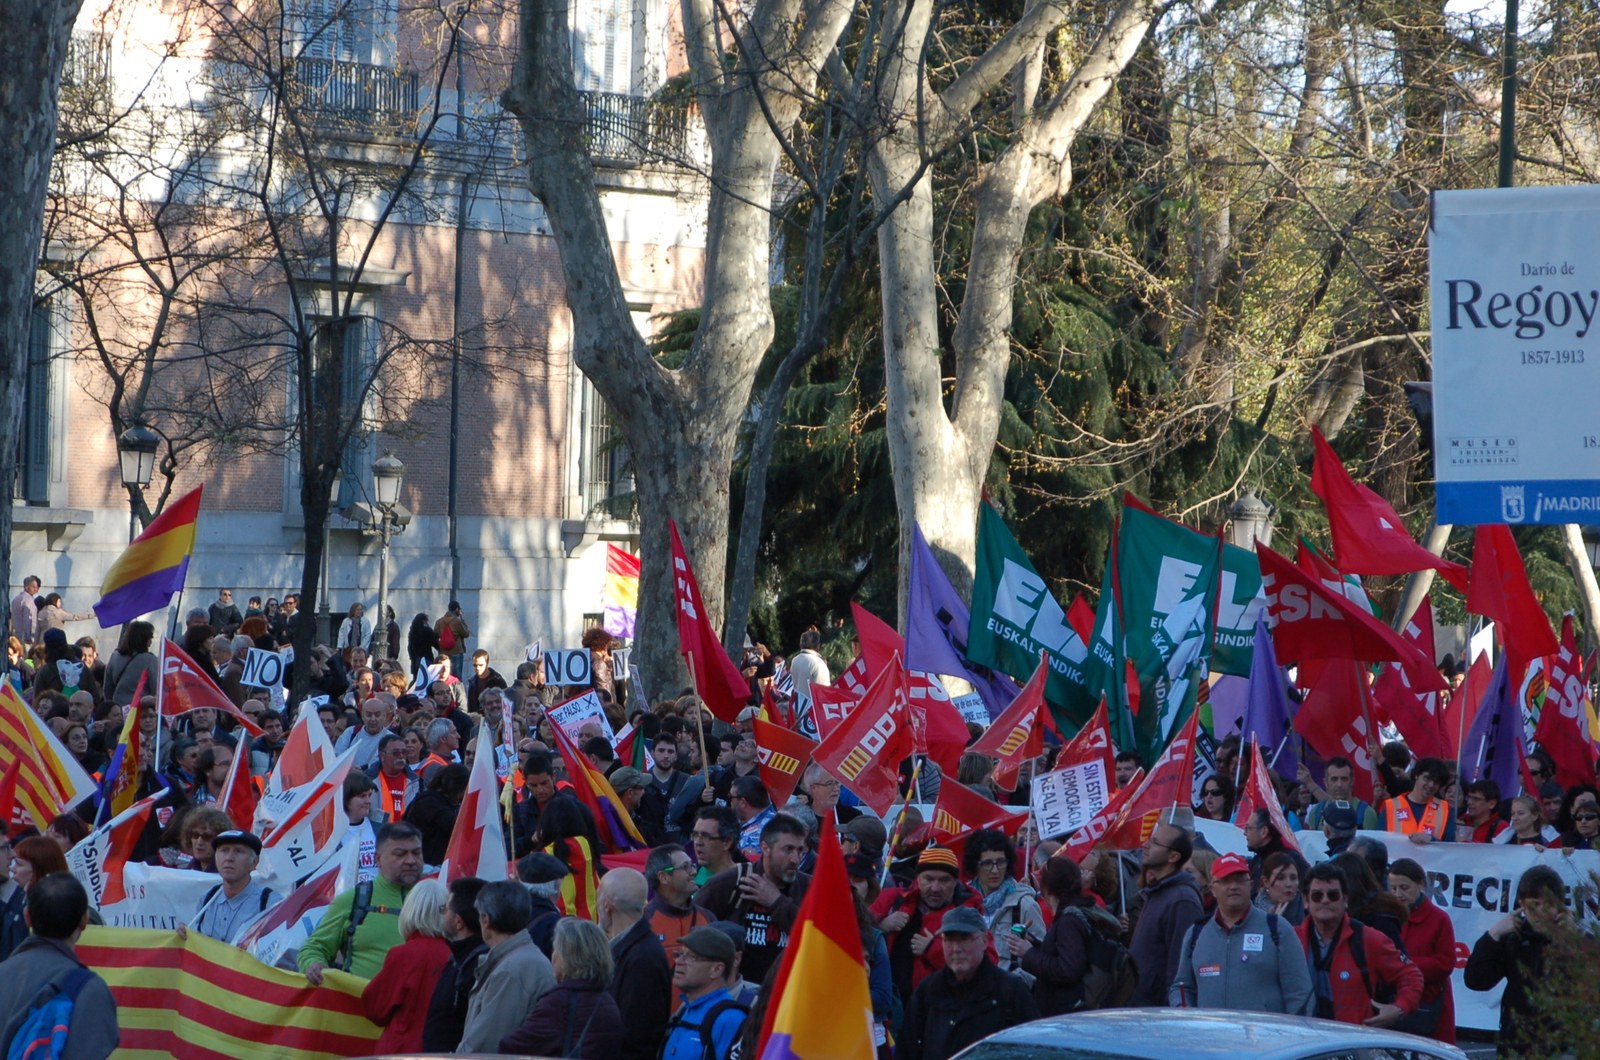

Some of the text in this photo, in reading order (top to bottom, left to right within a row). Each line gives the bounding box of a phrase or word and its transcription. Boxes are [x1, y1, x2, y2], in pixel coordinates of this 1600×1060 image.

[1521, 261, 1575, 276] Darío de
[1445, 279, 1600, 340] Regoy
[1521, 351, 1585, 365] 1857-1913
[1451, 438, 1516, 447] MUSEO
[987, 617, 1085, 685] EUSKAL SNDIK
[1214, 632, 1256, 647] SINDIK
[243, 650, 281, 687] NO
[544, 651, 589, 682] NO
[1083, 763, 1099, 781] SIN
[1040, 775, 1061, 834] REAL, YA!
[1061, 769, 1082, 827] DEMOCRACIA
